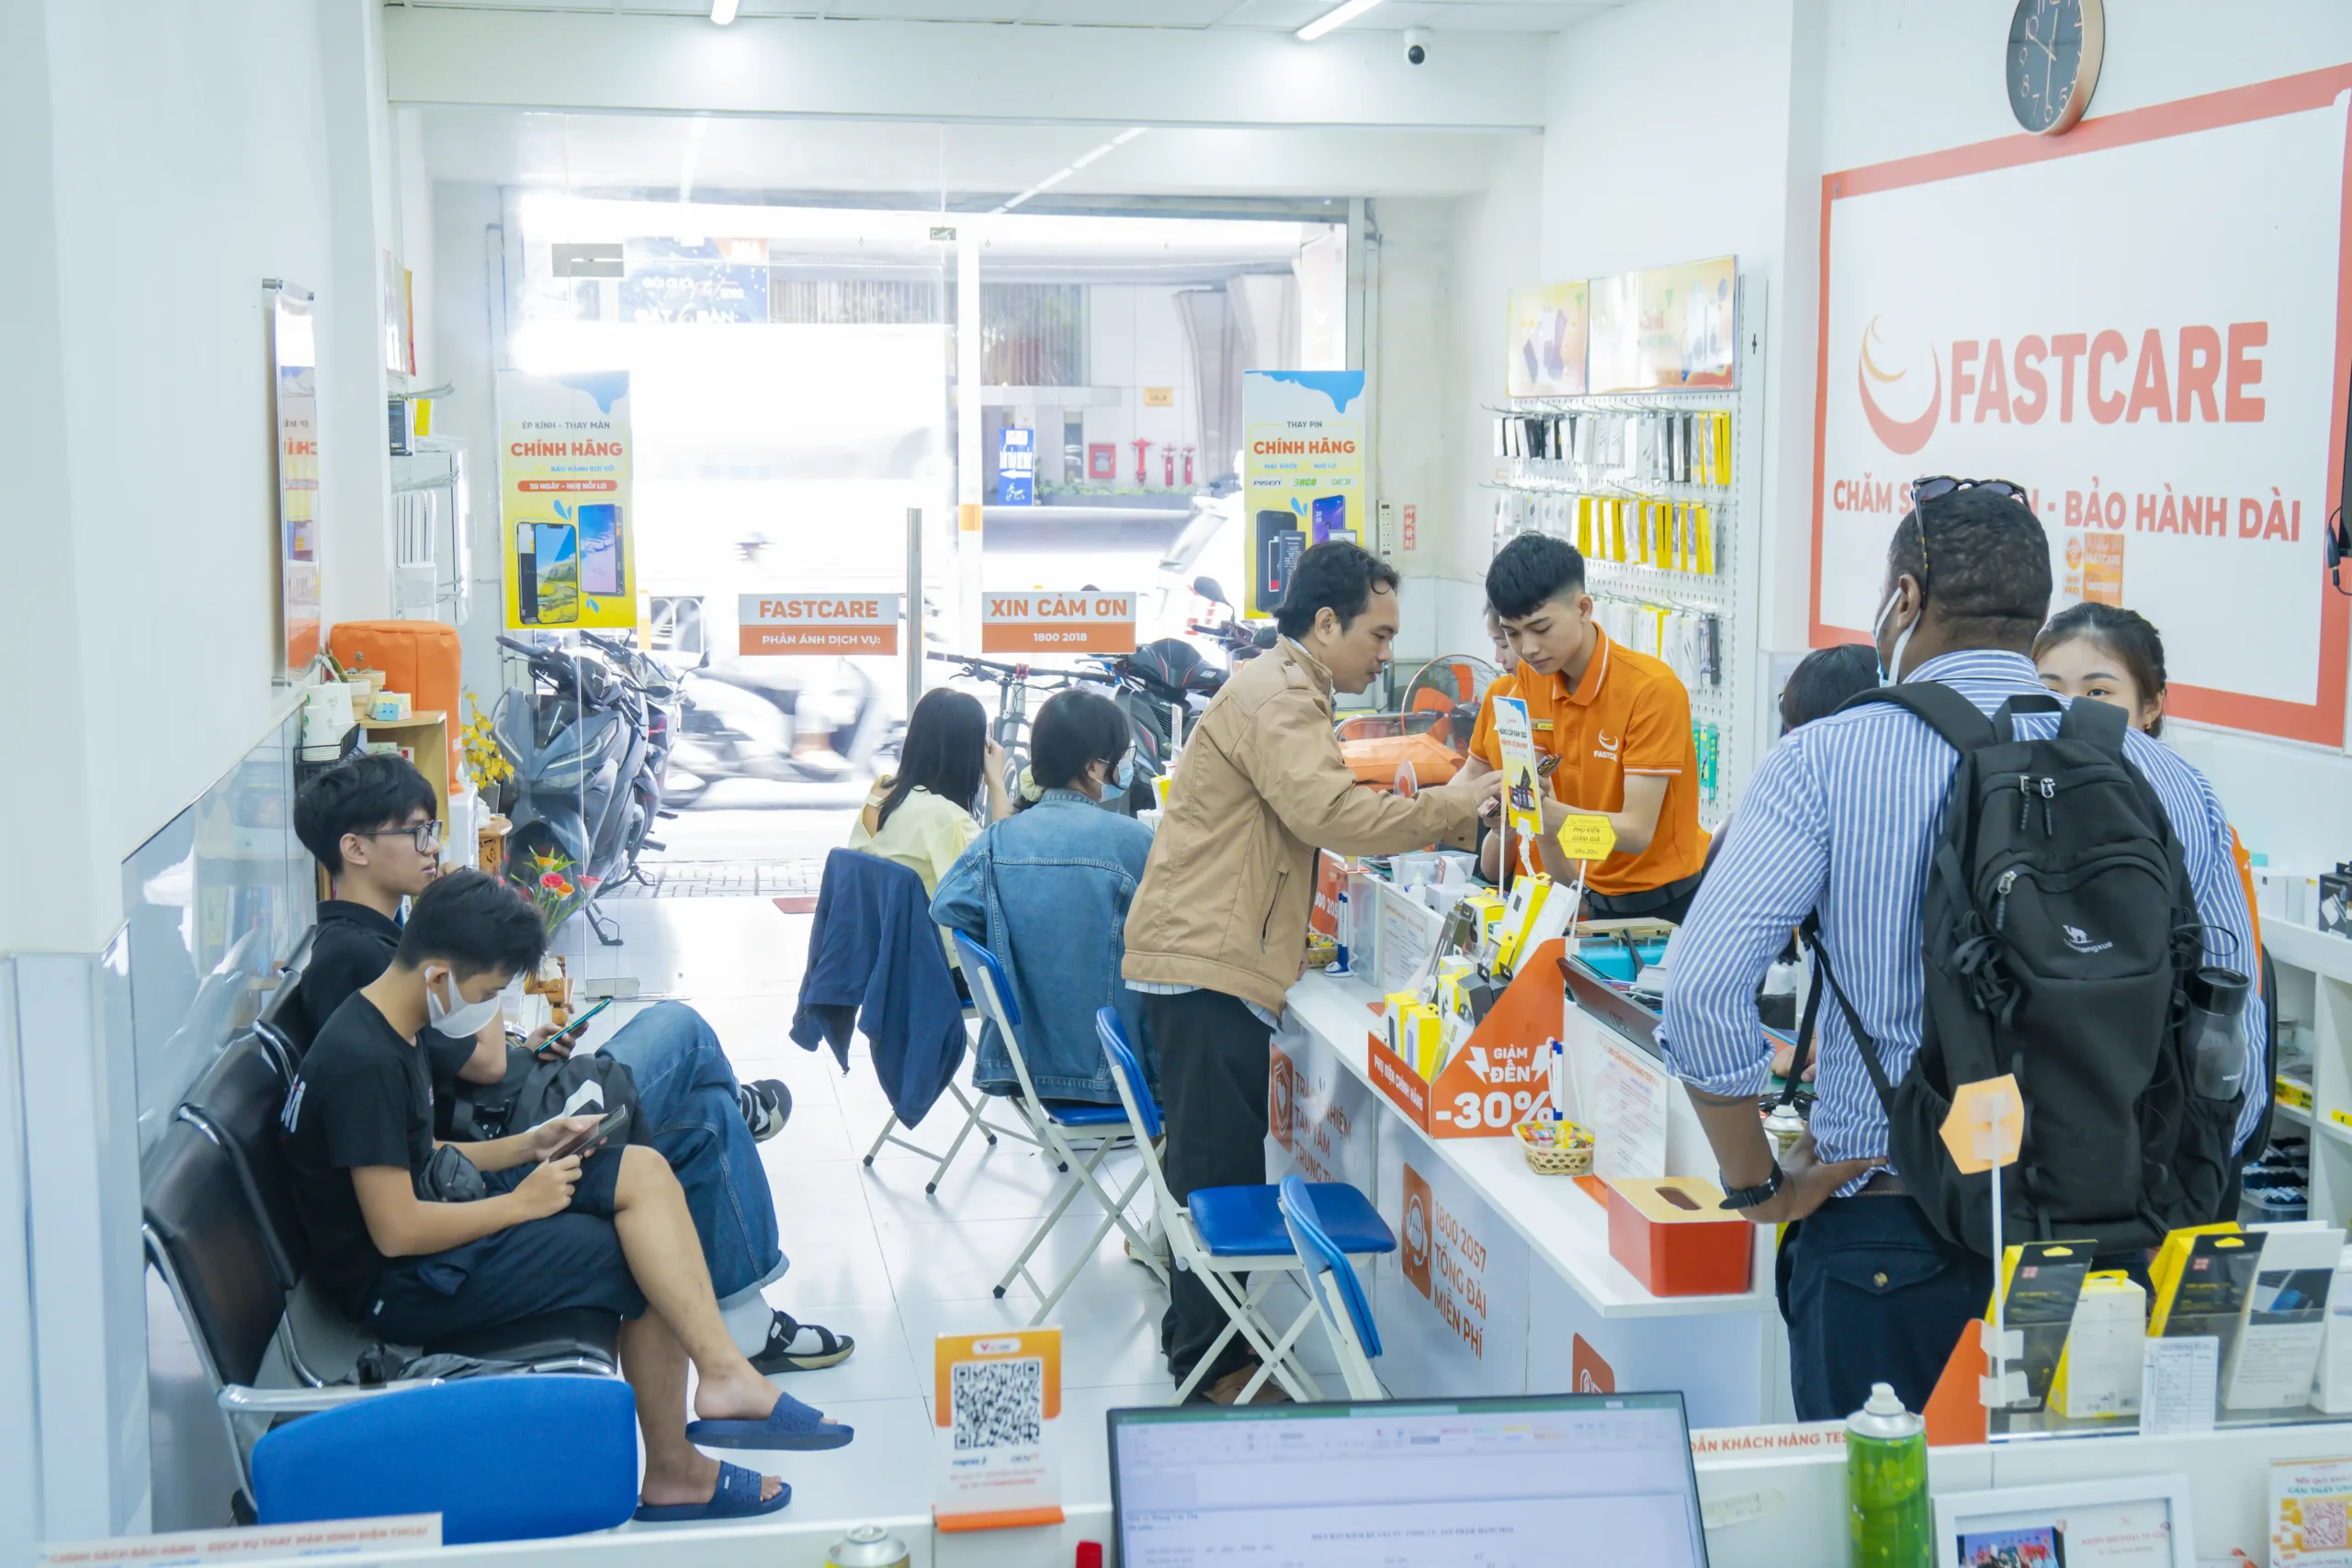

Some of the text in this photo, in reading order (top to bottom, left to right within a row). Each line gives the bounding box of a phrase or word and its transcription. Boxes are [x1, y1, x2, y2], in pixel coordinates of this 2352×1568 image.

[2025, 16, 2040, 41] 10
[2018, 47, 2029, 67] 9
[2020, 73, 2030, 98] 8
[2031, 93, 2041, 117] 7
[2043, 104, 2054, 123] 6
[1950, 321, 2268, 424] FASTCARE
[535, 420, 556, 430] KÍNH
[565, 421, 588, 430] THAY
[590, 420, 610, 430] MÀN
[1286, 420, 1323, 429] THAY PIN
[510, 438, 624, 457] CHÍNH HÃNG
[1253, 436, 1356, 456] CHÍNH HÃNG
[1833, 471, 1893, 515] CHĂM
[2064, 476, 2127, 531] BẢO
[2135, 482, 2227, 537] HÀNH
[2238, 487, 2301, 542] DÀI
[759, 600, 879, 618] FASTCARE
[990, 592, 1127, 617] XIN CẢM ƠN
[762, 632, 881, 647] PHẢN ÁNH DỊCH VỤ:
[1033, 632, 1088, 642] 1800 2018
[1493, 1043, 1528, 1059] GIẢM
[1489, 1058, 1532, 1084] ĐẾN
[1435, 1090, 1555, 1130] -30%
[1295, 1139, 1322, 1183] TRUNG
[1434, 1201, 1487, 1274] 1800 2057
[1434, 1240, 1487, 1321] TỔNG ĐÀI
[1434, 1284, 1484, 1360] MIỄN PHÍ
[1722, 1433, 1774, 1451] KHÁCH
[1778, 1431, 1821, 1449] HÀNG
[1826, 1430, 1848, 1445] TES
